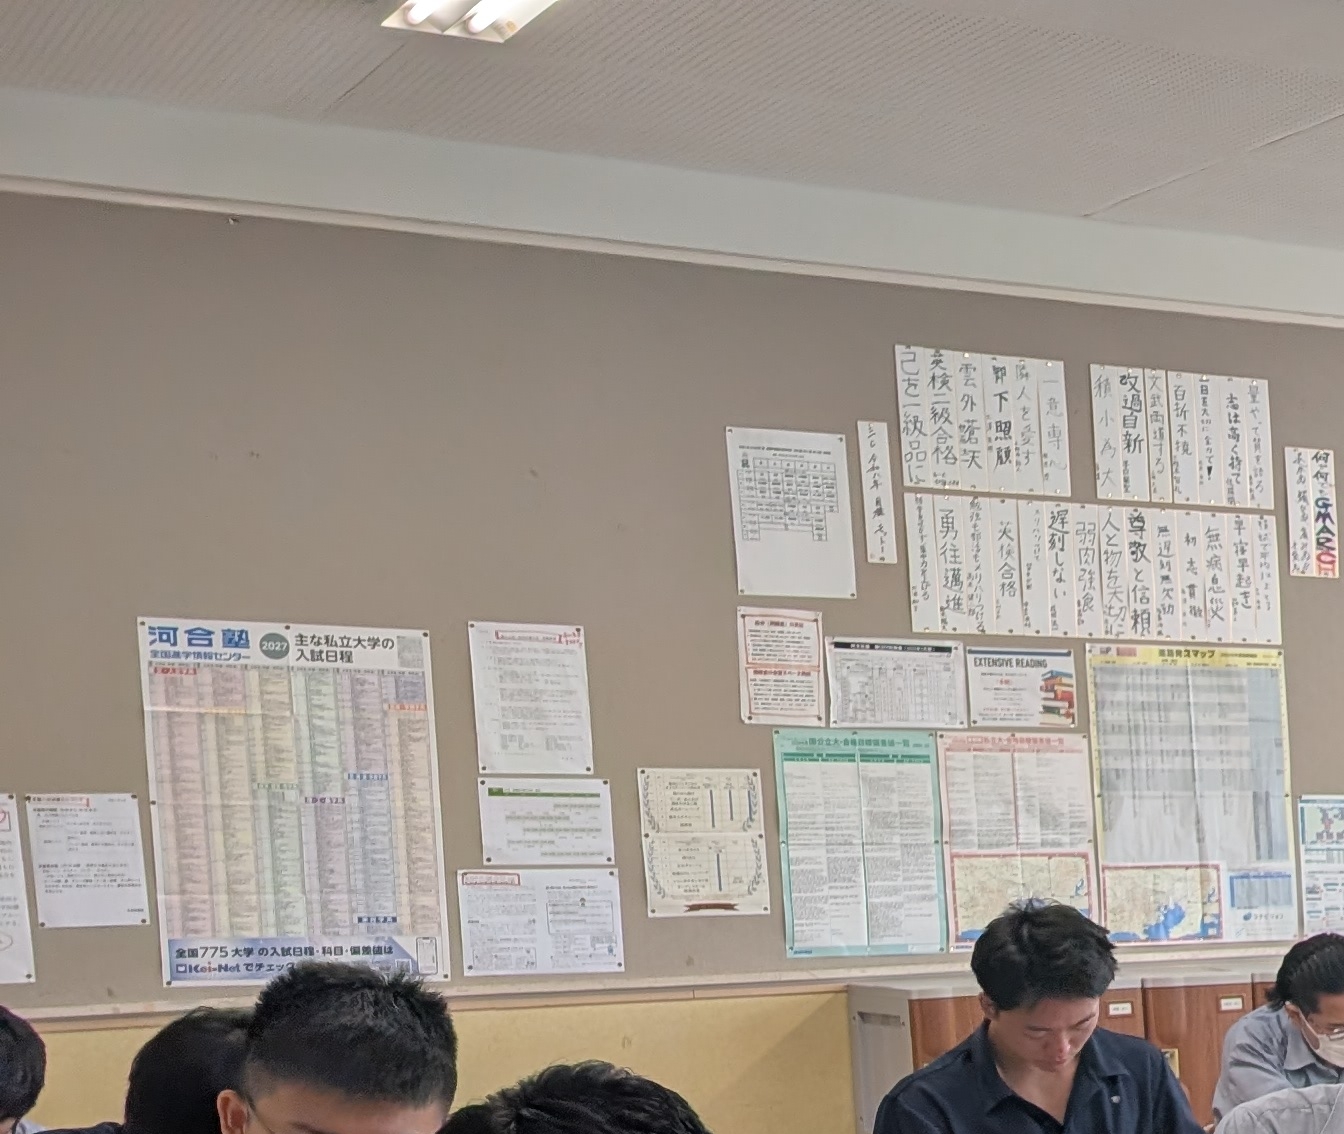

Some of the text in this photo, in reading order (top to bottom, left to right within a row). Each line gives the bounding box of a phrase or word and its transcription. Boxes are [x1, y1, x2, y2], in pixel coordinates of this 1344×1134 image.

[901, 352, 928, 484] 己を一級品に
[927, 350, 958, 465] 英検二級合格
[1120, 374, 1144, 455] 改過自新
[939, 508, 966, 615] 勇往邁進
[1048, 509, 1070, 599] 遅刻しない
[1076, 521, 1097, 612] 弱肉強食
[1102, 512, 1127, 638] 人と物を大切に
[1128, 511, 1151, 635] 尊敬と信頼
[1205, 526, 1225, 621] 無病息災
[1233, 519, 1251, 609] 早寝早起き
[148, 625, 250, 649] 河合塾
[261, 640, 288, 651] 2027
[294, 633, 395, 650] 主な私立大学の
[295, 650, 353, 663] 入試日程
[974, 657, 1047, 668] EXTENSIVE READING
